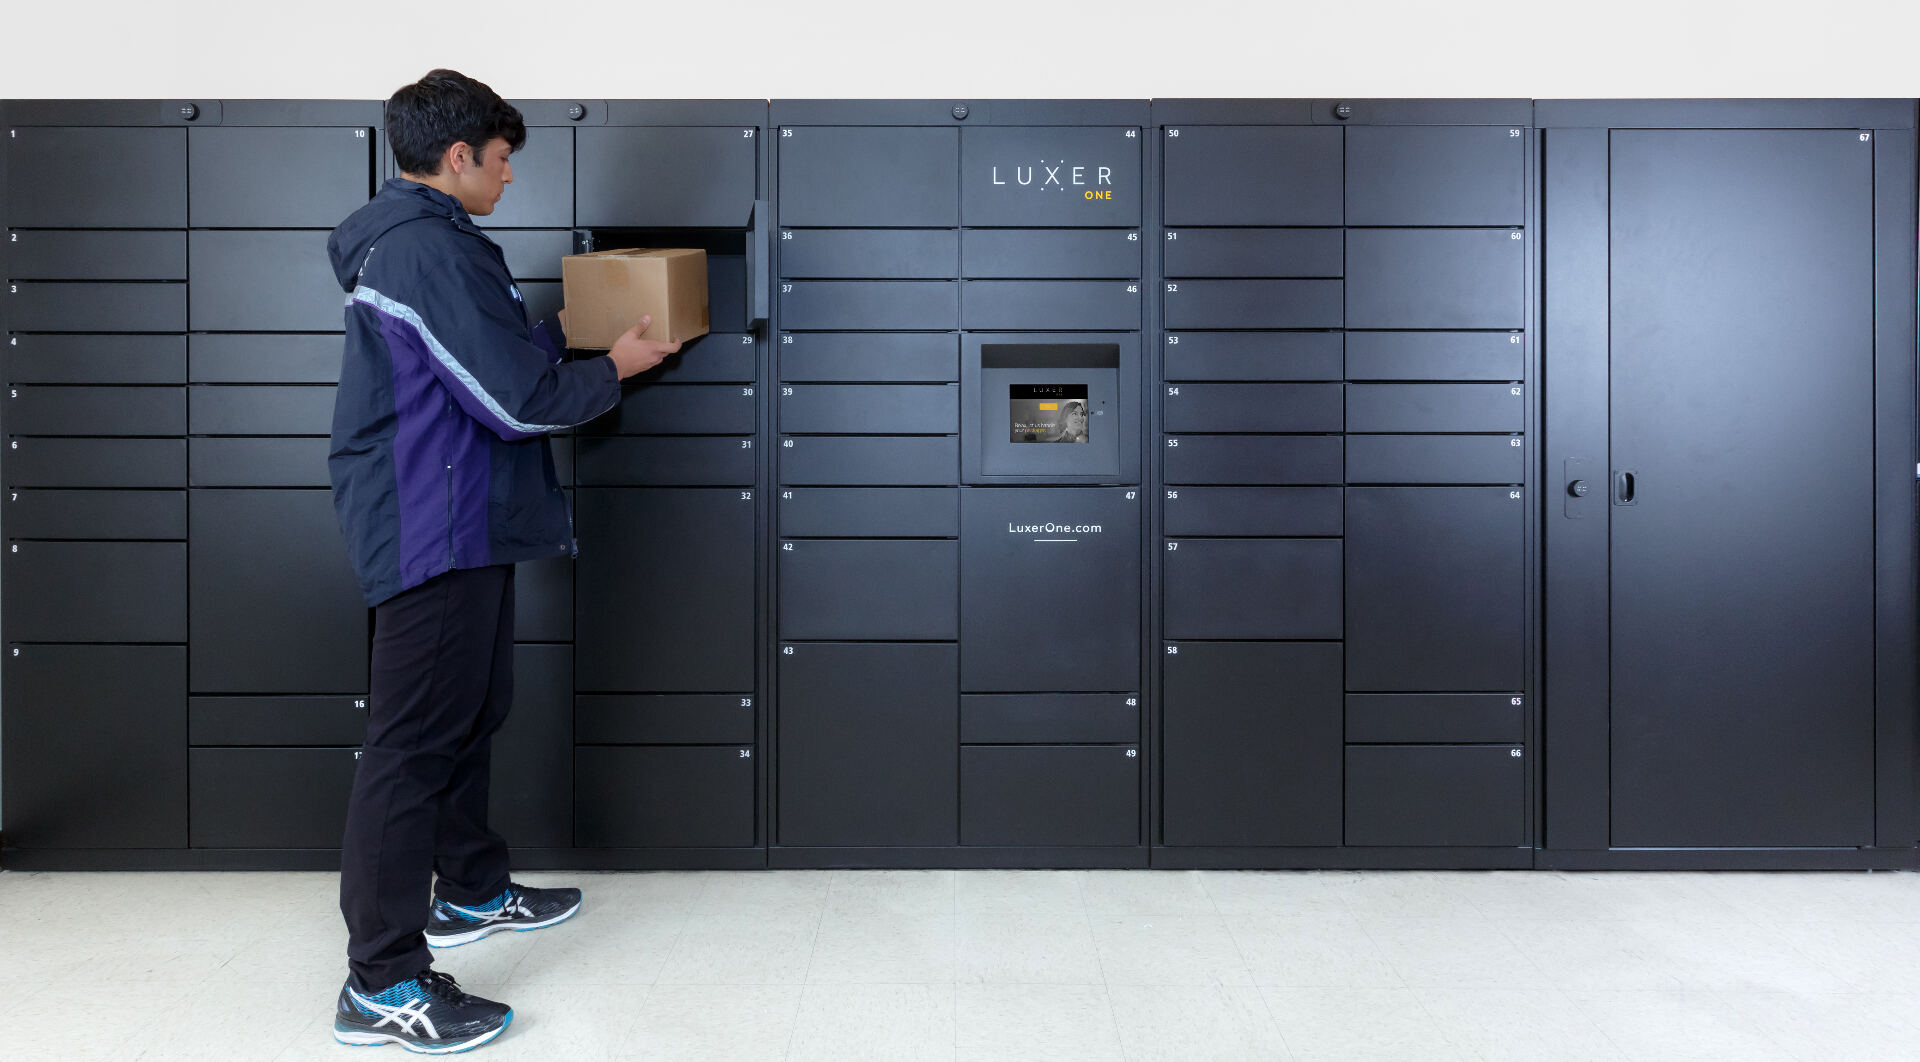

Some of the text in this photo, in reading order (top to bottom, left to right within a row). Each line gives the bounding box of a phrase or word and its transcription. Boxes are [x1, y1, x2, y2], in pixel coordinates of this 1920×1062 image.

[10, 129, 16, 138] 1
[354, 129, 365, 138] 10
[743, 129, 754, 138] 27
[782, 129, 793, 138] 35
[1125, 130, 1136, 138] 44
[1168, 129, 1179, 137] 50
[1509, 129, 1520, 138] 59
[1859, 133, 1870, 142] 67
[993, 166, 1112, 186] LUXER
[1084, 190, 1112, 200] ONE
[11, 233, 17, 242] 2
[782, 231, 793, 240] 36
[1127, 233, 1138, 241] 45
[1167, 232, 1177, 241] 51
[1510, 232, 1522, 241] 60
[10, 285, 17, 293] 3
[782, 284, 793, 293] 37
[1126, 285, 1138, 293] 46
[1167, 284, 1178, 292] 52
[10, 337, 17, 346] 4
[742, 336, 753, 344] 29
[782, 335, 793, 344] 38
[1168, 336, 1179, 345] 53
[1510, 335, 1520, 344] 61
[11, 389, 17, 398] 5
[742, 388, 753, 396] 30
[782, 387, 793, 396] 39
[1168, 387, 1179, 396] 54
[1510, 387, 1521, 396] 62
[11, 441, 18, 449] 6
[741, 440, 751, 449] 31
[783, 439, 794, 448] 40
[1167, 439, 1179, 447] 55
[1510, 438, 1521, 447] 63
[11, 493, 18, 501] 7
[740, 491, 751, 500] 32
[782, 491, 792, 500] 41
[1125, 491, 1136, 500] 47
[1167, 490, 1178, 499] 56
[1509, 491, 1521, 499] 64
[1009, 522, 1102, 533] LuxerOne.com
[11, 544, 18, 553] 8
[782, 543, 794, 551] 42
[1167, 542, 1178, 551] 57
[13, 648, 20, 657] 9
[783, 646, 794, 655] 43
[1167, 646, 1178, 655] 58
[354, 699, 365, 708] 16
[740, 698, 751, 707] 33
[1125, 698, 1137, 707] 48
[1511, 697, 1522, 706] 65
[739, 749, 751, 758] 34
[1125, 749, 1137, 758] 49
[1510, 748, 1522, 758] 66
